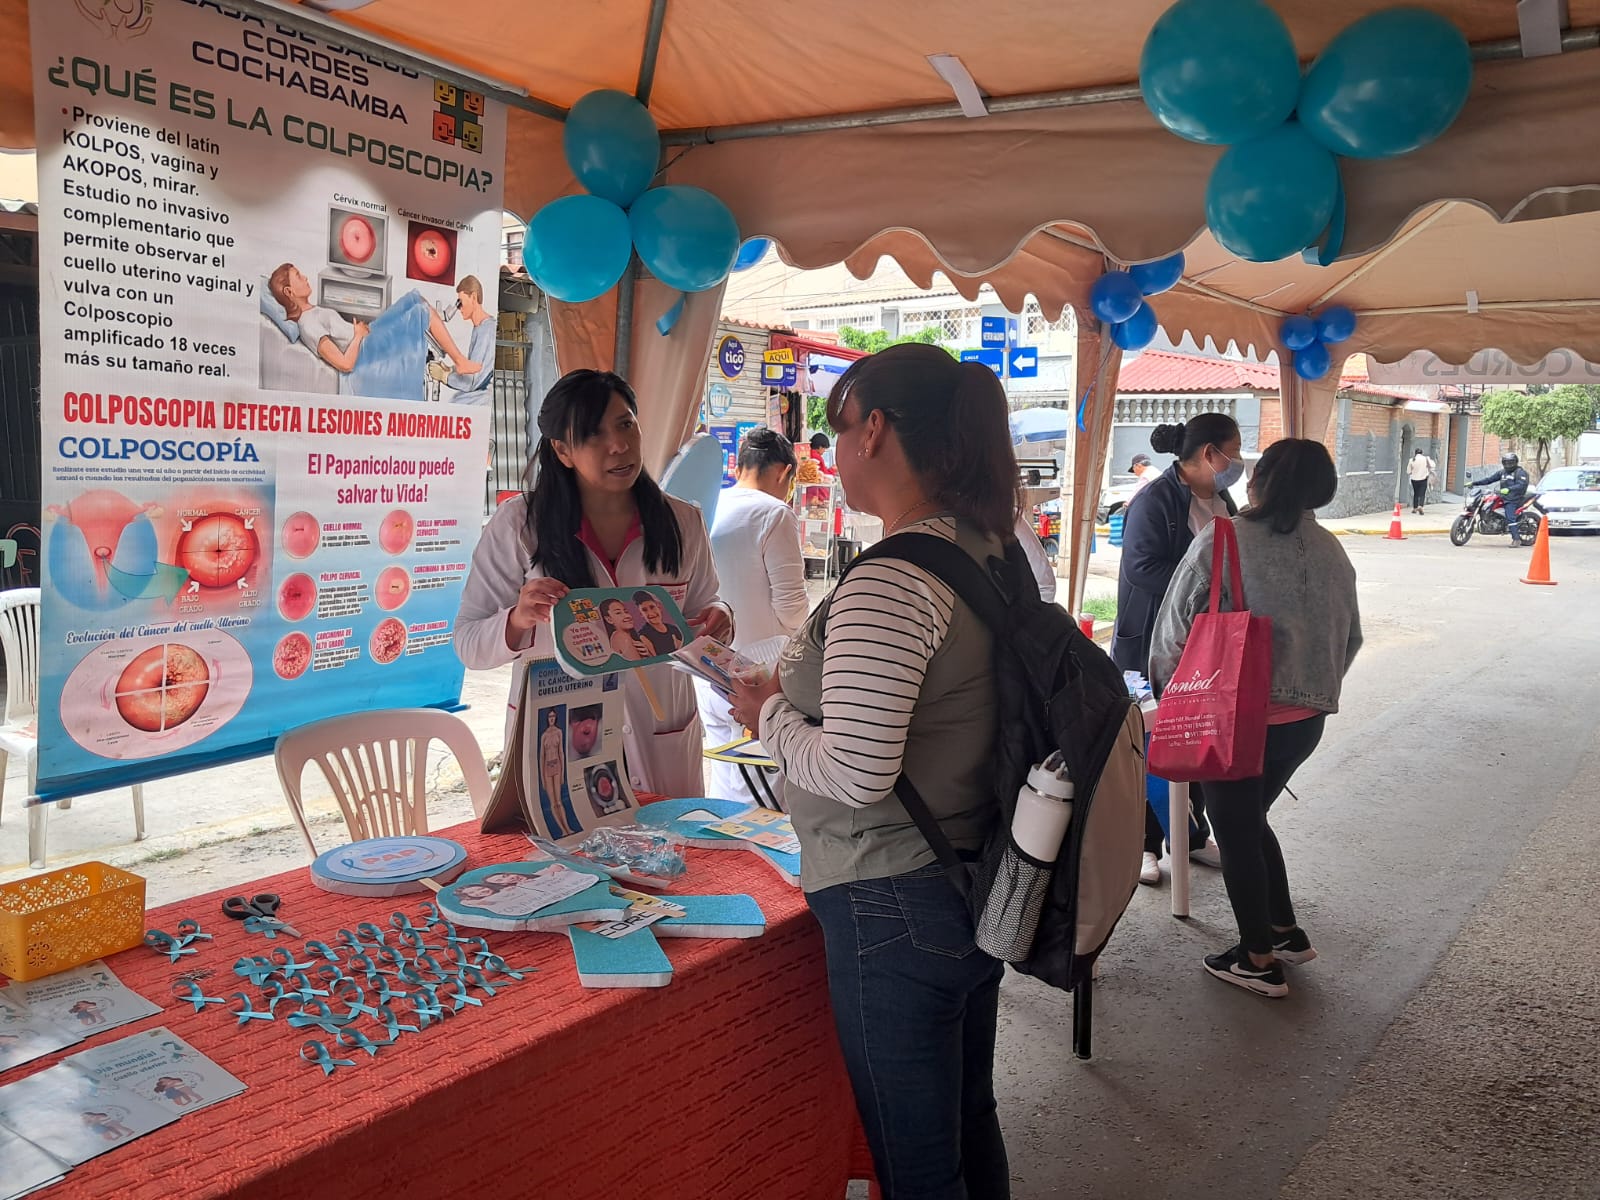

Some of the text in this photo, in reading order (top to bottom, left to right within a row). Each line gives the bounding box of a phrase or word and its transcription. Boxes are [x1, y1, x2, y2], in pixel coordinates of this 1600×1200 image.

[243, 30, 369, 86] CORDES
[192, 41, 409, 124] COCHABAMBA
[48, 56, 493, 193] ¿QUÉ ES LA COLPOSCOPIA?
[72, 106, 220, 155] Proviene del latín
[62, 129, 220, 181] KOLPOS, vagina y
[62, 154, 200, 196] AKOPOS, mirar.
[63, 180, 230, 225] Estudio no invasivo
[333, 192, 387, 213] Cérvix normal
[63, 208, 235, 251] complementario que
[397, 207, 420, 220] Cáncer
[445, 218, 455, 228] del
[63, 232, 226, 269] permite observar el
[63, 253, 255, 299] cuello uterino vaginal y
[63, 278, 174, 306] vulva con un
[63, 301, 174, 329] Colposcopio
[63, 325, 237, 358] amplificado 18 veces
[64, 350, 231, 378] más su tamaño real.
[725, 350, 744, 364] tigo
[63, 391, 472, 440] COLPOSCOPIA DETECTA LESIONES ANORMALES
[58, 436, 260, 462] COLPOSCOPÍA
[308, 453, 455, 479] El Papanicolaou puede
[337, 483, 428, 504] salvar tu Vida!
[66, 629, 116, 645] Evolución
[119, 626, 135, 640] del
[173, 621, 187, 633] del
[190, 621, 214, 632] cuello
[576, 643, 605, 657] VPH
[538, 680, 546, 688] EL
[538, 681, 593, 697] CUELLO UTERINO
[115, 1050, 157, 1067] mundial
